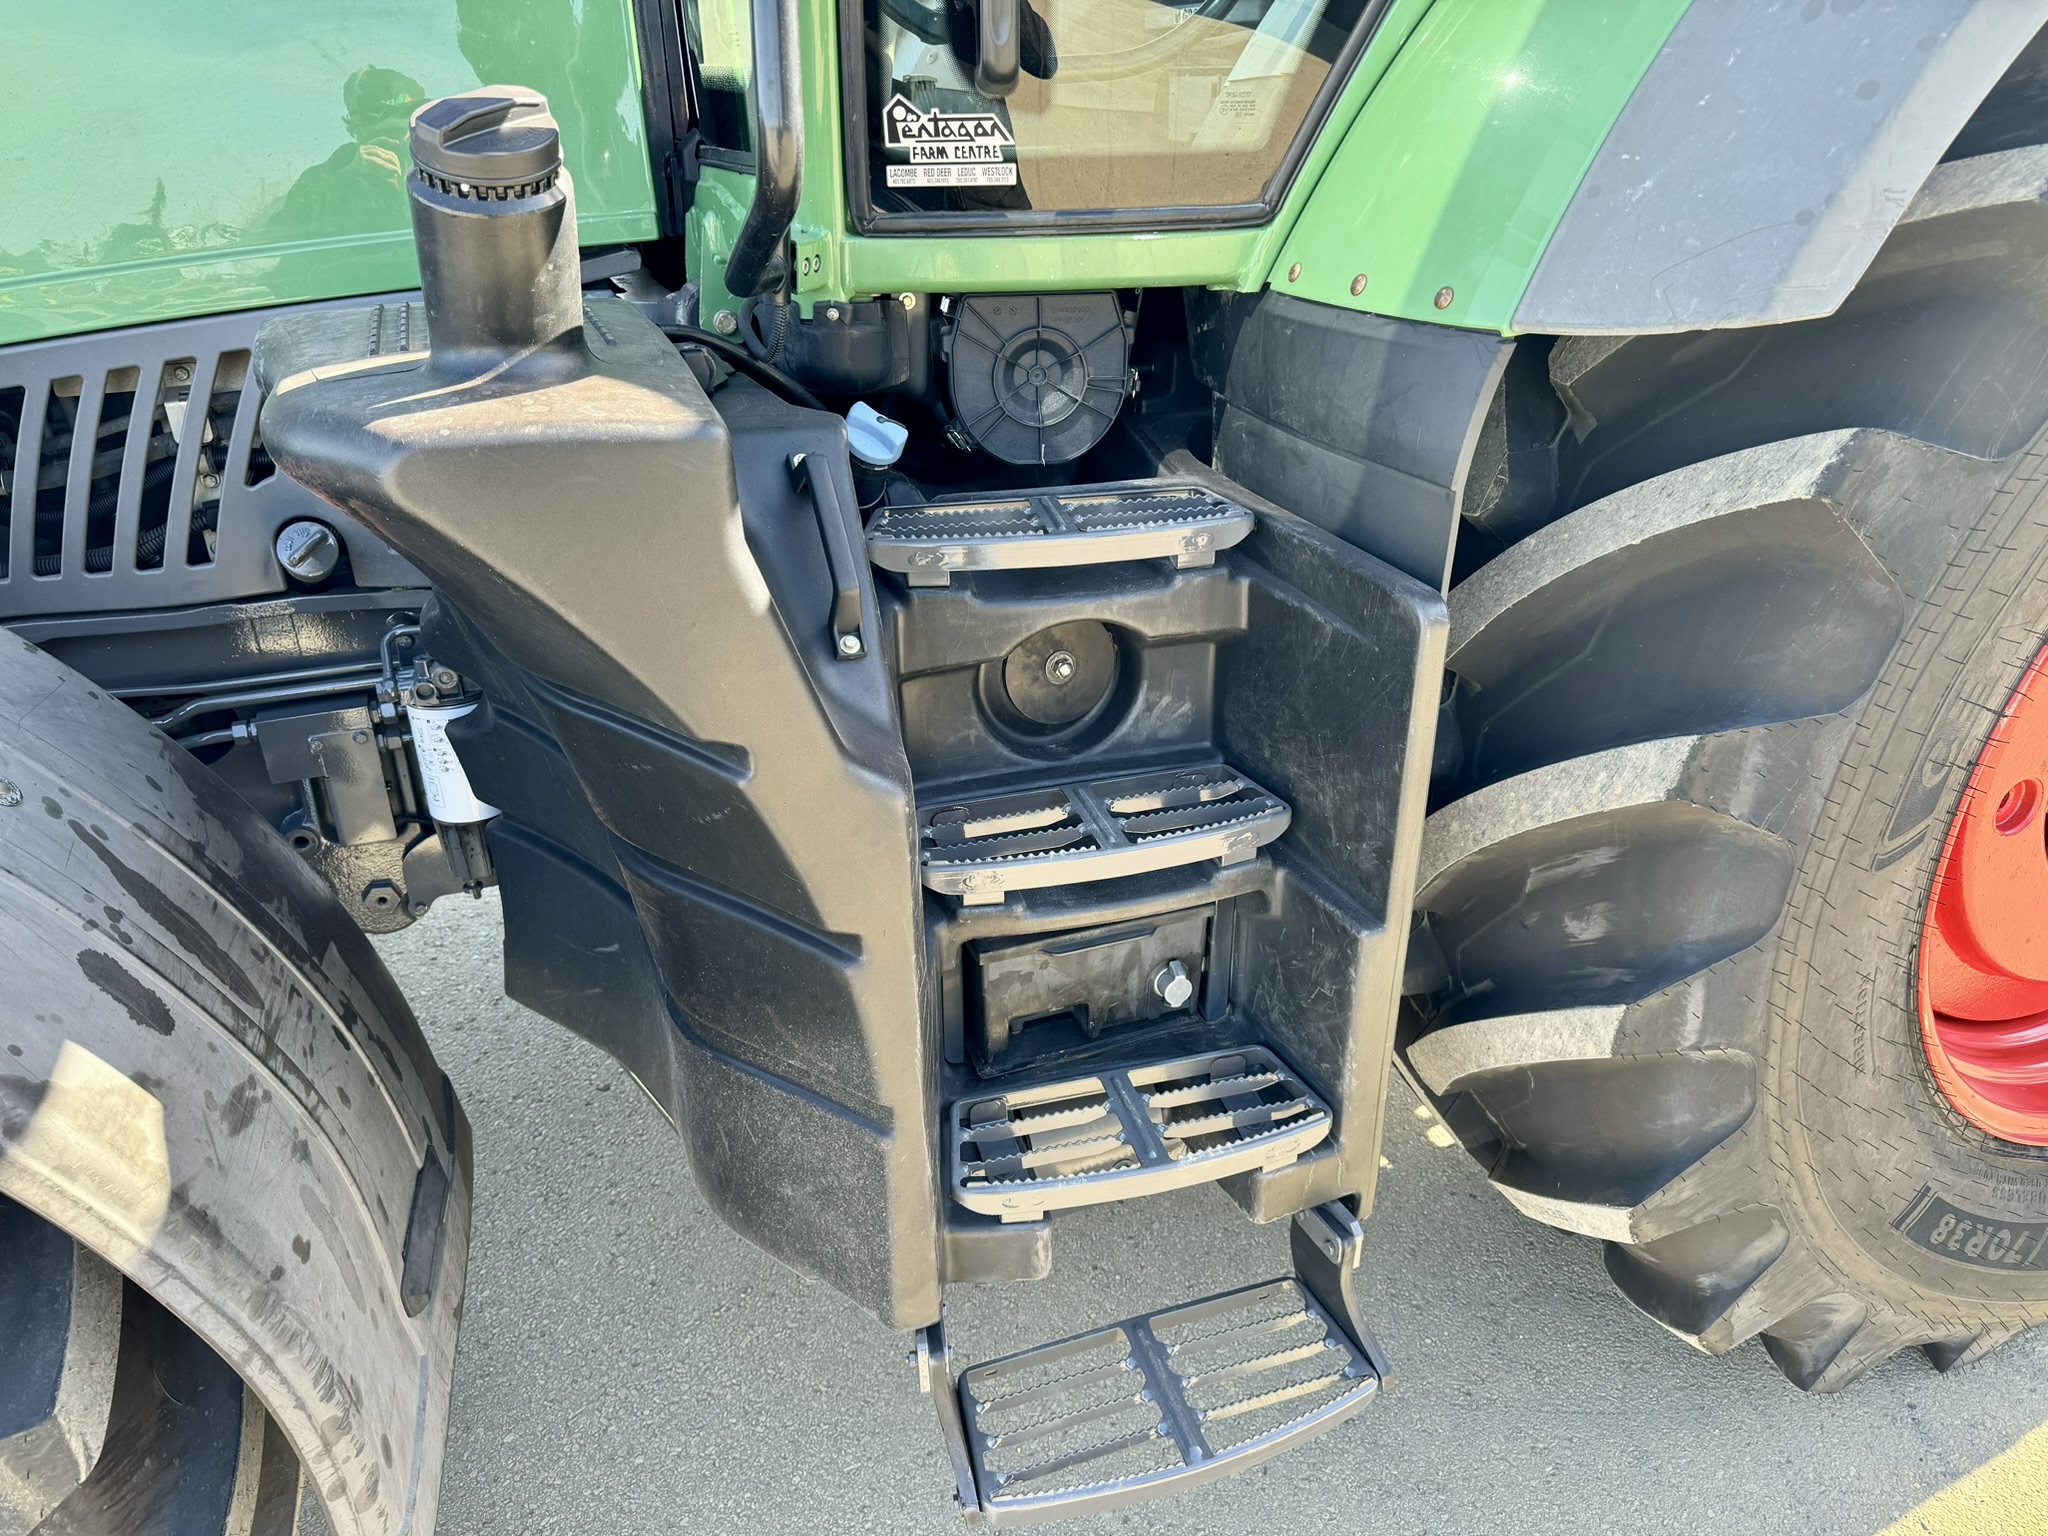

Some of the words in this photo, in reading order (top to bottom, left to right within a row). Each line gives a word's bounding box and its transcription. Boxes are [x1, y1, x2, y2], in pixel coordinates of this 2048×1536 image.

[887, 98, 1010, 143] Pentagon
[913, 146, 949, 160] FARM
[955, 145, 1000, 159] CENTRE
[889, 168, 917, 178] LACOMBE
[923, 168, 935, 177] RED
[937, 167, 952, 177] DEER
[957, 167, 976, 177] LEDUC
[982, 166, 1013, 176] WESTLOCK
